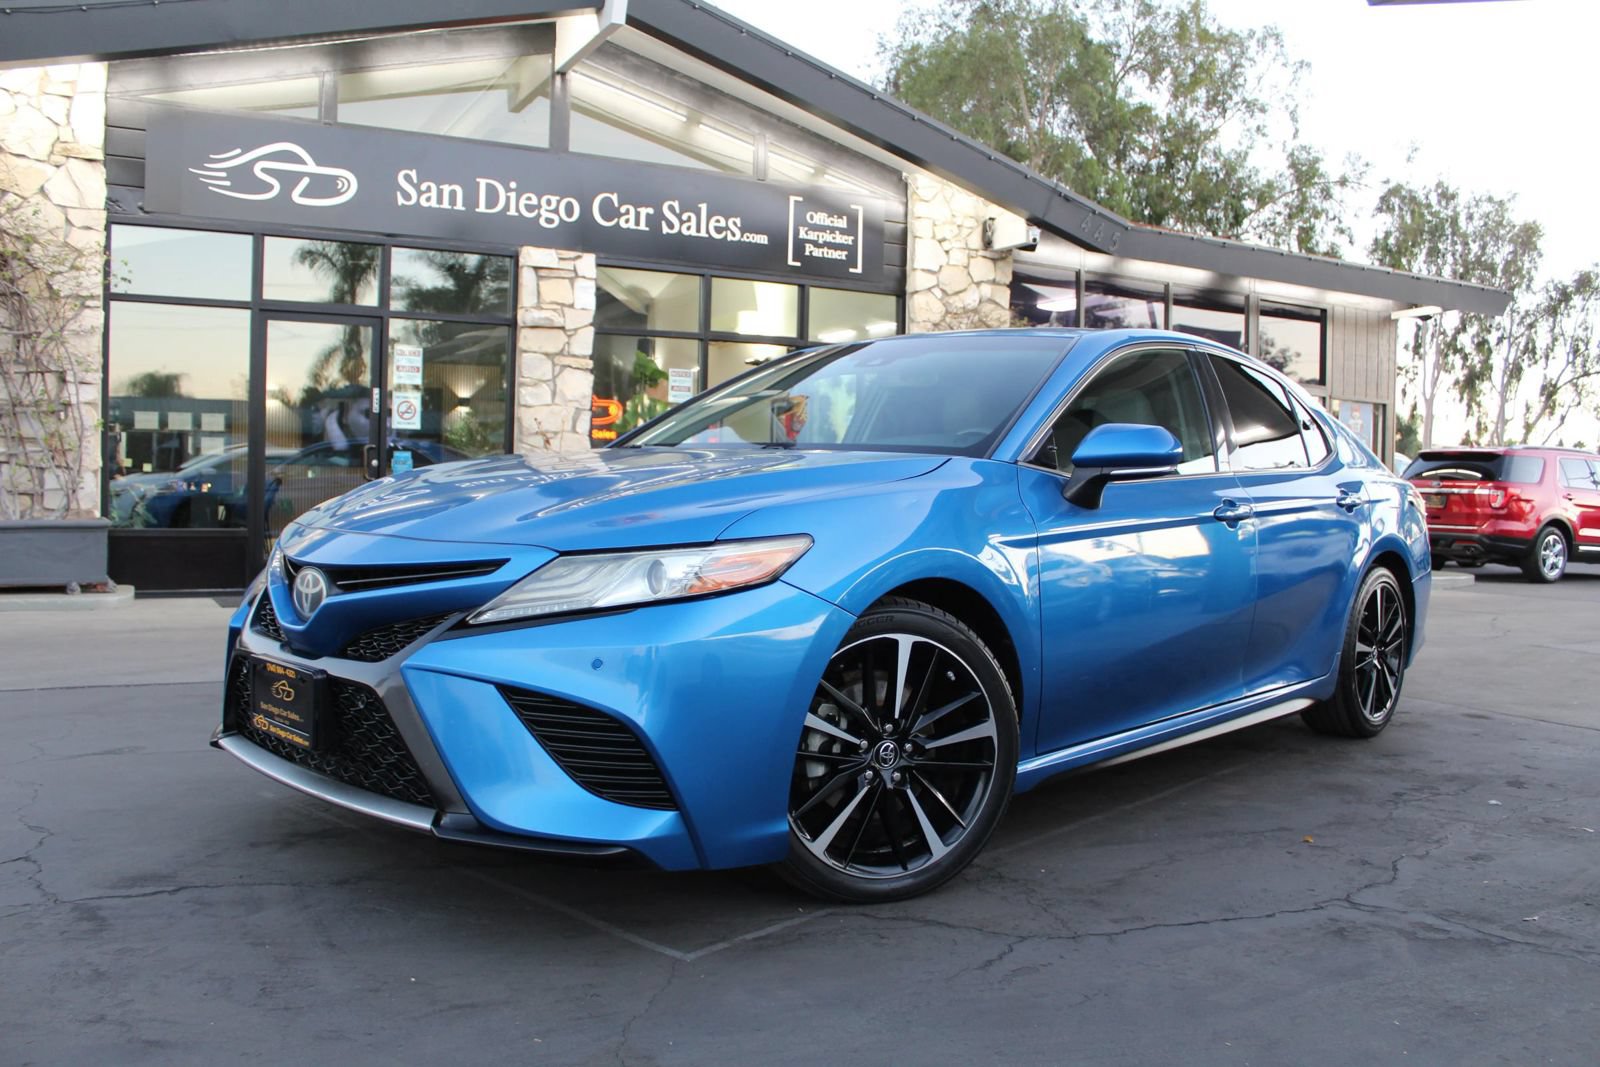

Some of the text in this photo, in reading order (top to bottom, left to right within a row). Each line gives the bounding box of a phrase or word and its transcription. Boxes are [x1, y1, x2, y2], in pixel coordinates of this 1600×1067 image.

[396, 169, 466, 211] San
[475, 177, 581, 229] Diego
[592, 192, 655, 231] Car
[806, 211, 847, 229] Official
[798, 226, 855, 245] Karpicker
[804, 243, 848, 260] Partner
[592, 429, 616, 439] Sales
